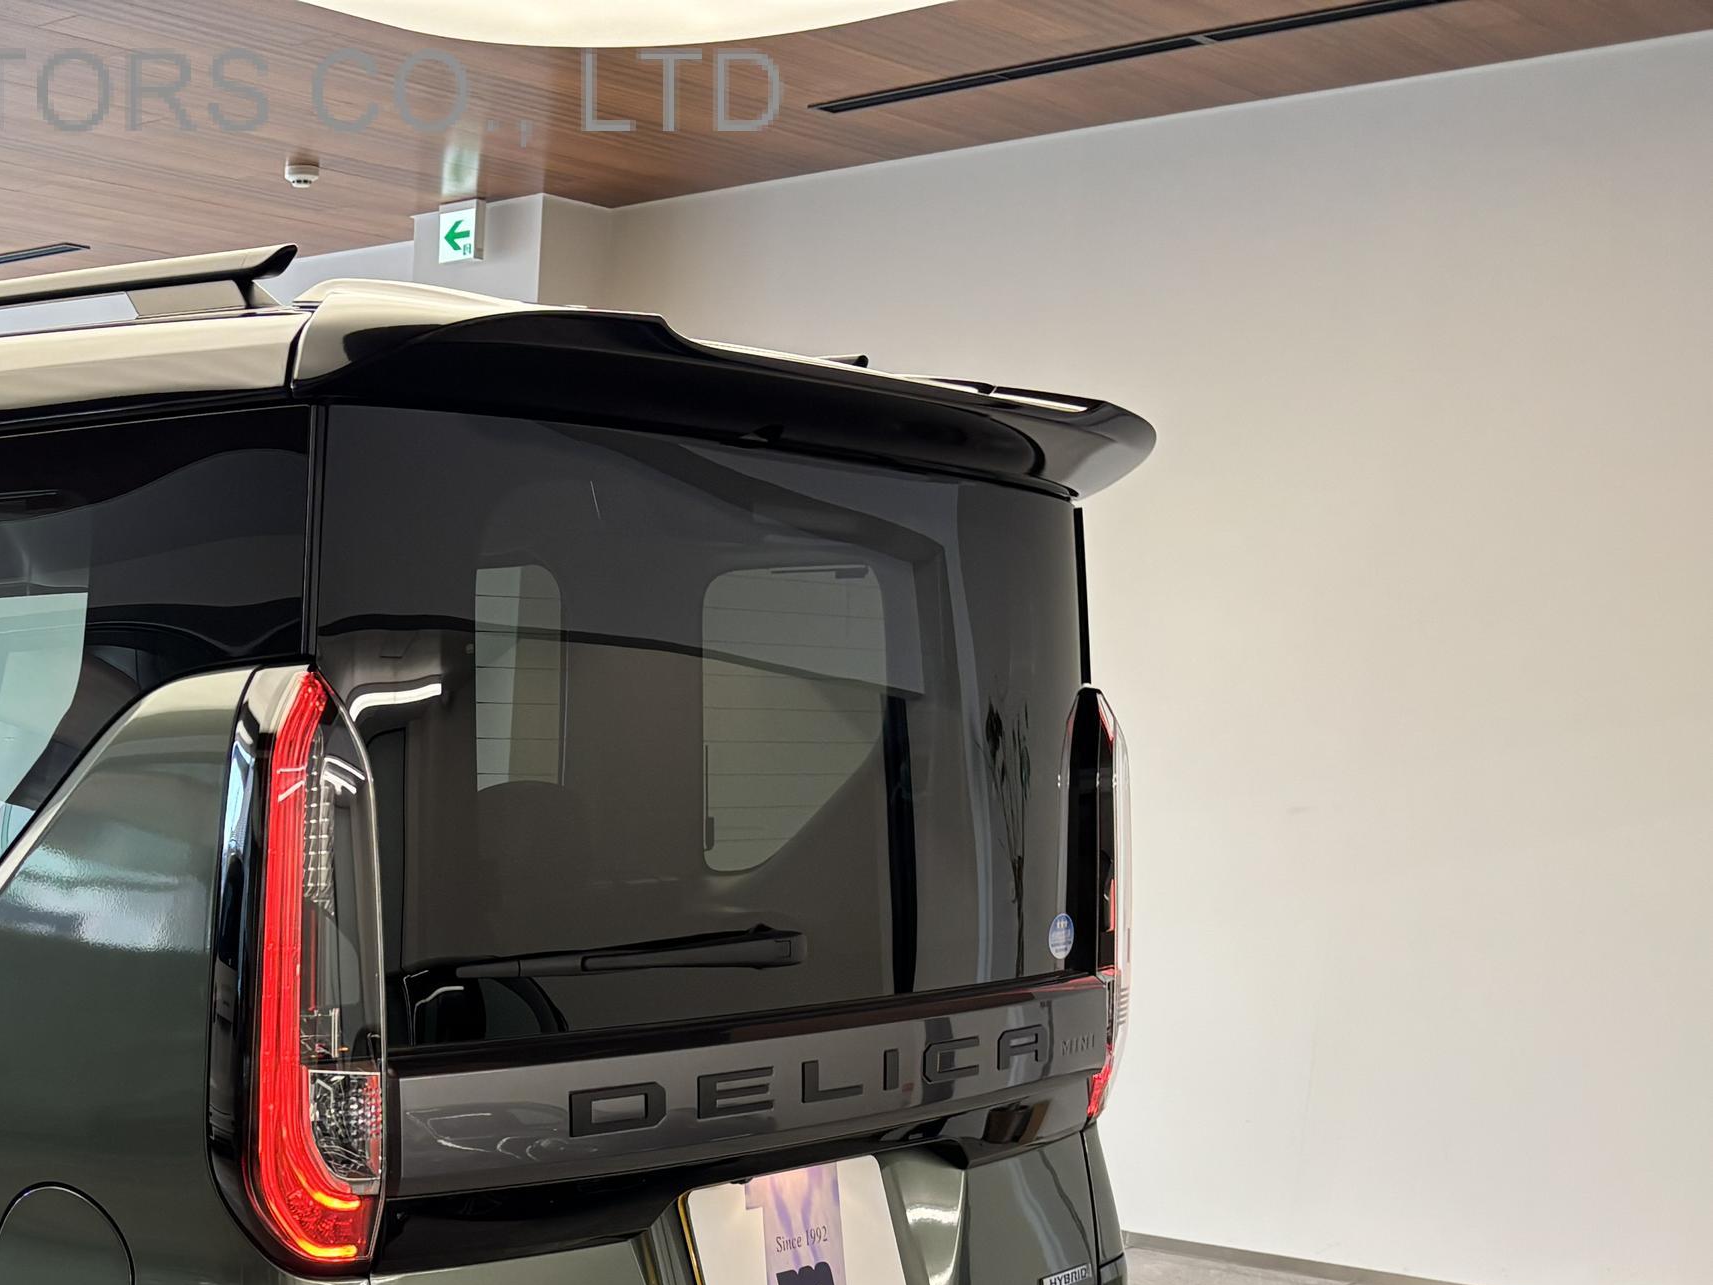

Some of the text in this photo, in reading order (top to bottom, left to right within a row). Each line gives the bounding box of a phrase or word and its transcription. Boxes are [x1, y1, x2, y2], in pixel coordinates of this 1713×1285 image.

[568, 1023, 1096, 1138] DELICA MINI
[775, 1225, 829, 1253] Since 1992
